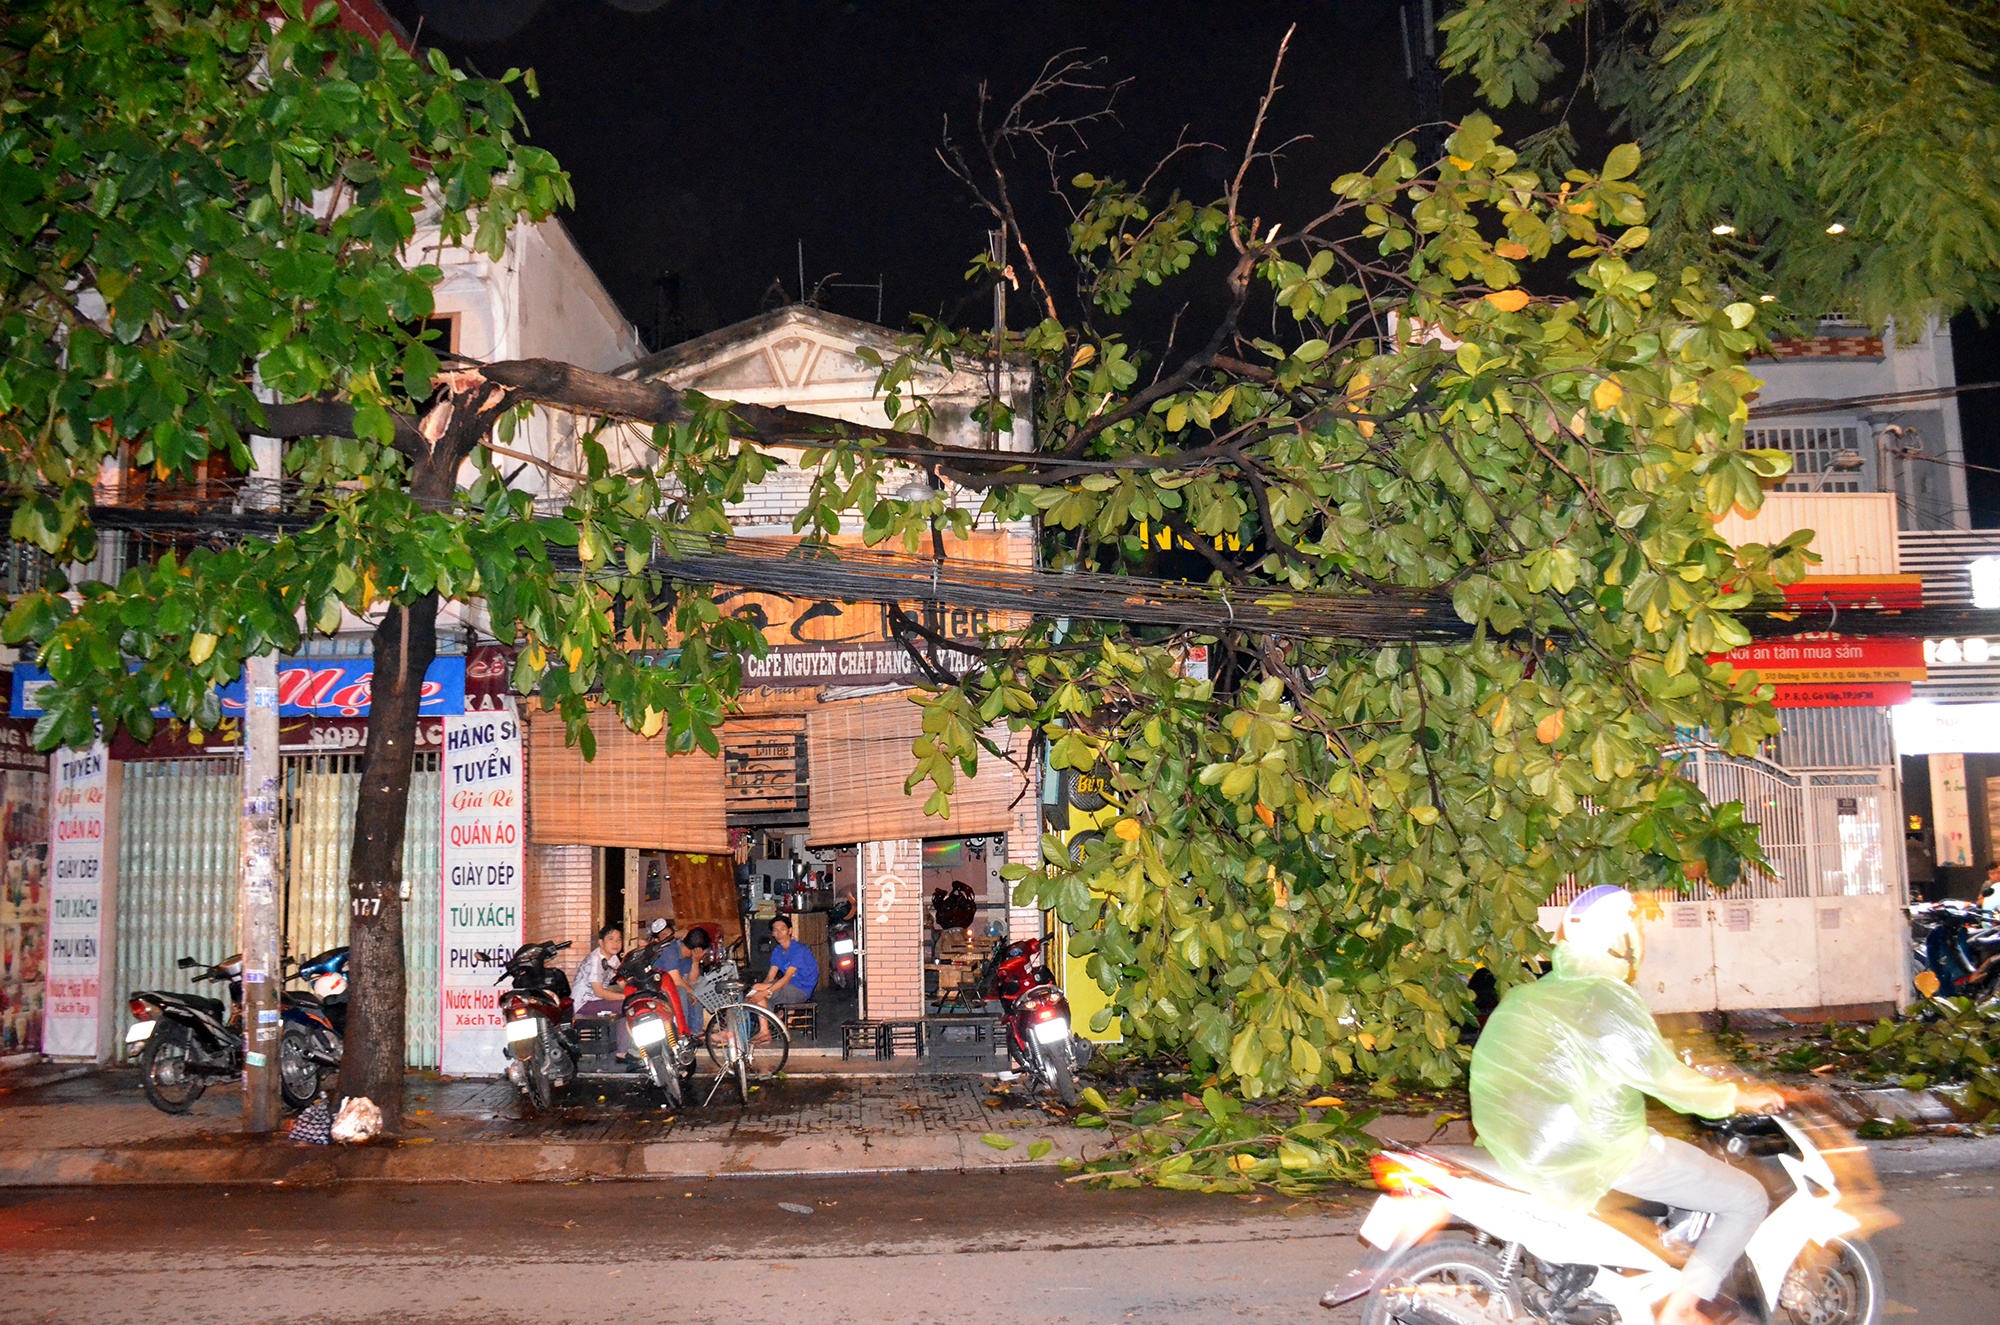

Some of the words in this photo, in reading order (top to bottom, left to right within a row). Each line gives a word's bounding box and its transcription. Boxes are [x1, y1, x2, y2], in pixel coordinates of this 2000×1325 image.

[748, 647, 781, 678] CAFÉ
[784, 647, 836, 677] NGUYÊN
[876, 650, 911, 675] RANG
[1754, 648, 1770, 660] an
[1774, 645, 1799, 660] tâm
[1803, 647, 1831, 659] mua
[448, 724, 495, 750] HÀNG
[453, 747, 512, 784] TUYỂN
[452, 790, 483, 811] Giá
[489, 789, 513, 808] Rẻ
[451, 819, 491, 847] QUẦN
[495, 820, 516, 844] ÁO
[451, 861, 484, 886] GIÀY
[487, 861, 515, 886] DÉP
[352, 898, 381, 916] 177
[450, 903, 473, 927] TÚI
[476, 903, 515, 927] XÁCH
[450, 948, 479, 974] PHỤ
[483, 944, 515, 974] KIỆN
[446, 989, 472, 1010] Nước
[474, 989, 494, 1010] Hoa
[456, 1013, 485, 1026] Xách
[488, 1014, 507, 1028] Tay
